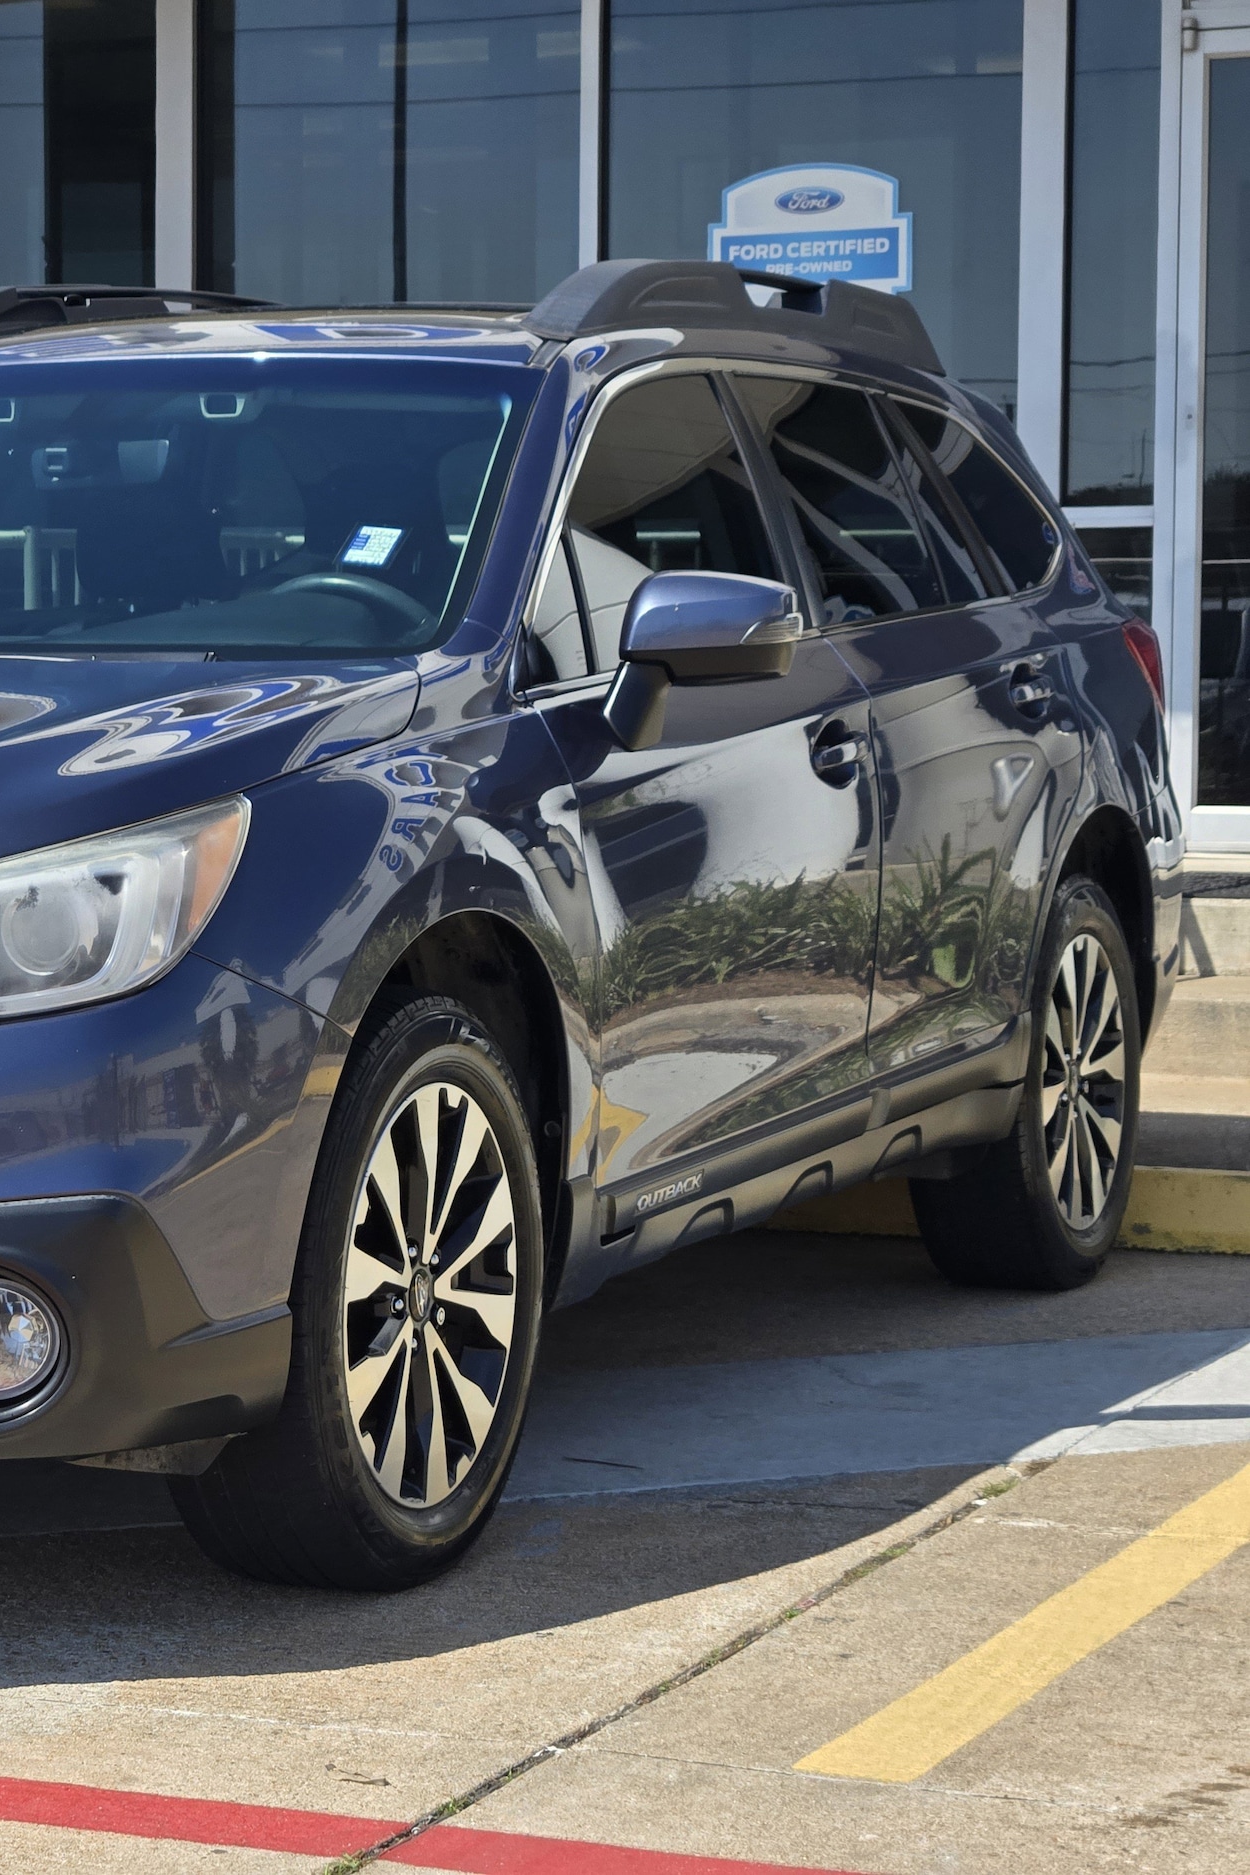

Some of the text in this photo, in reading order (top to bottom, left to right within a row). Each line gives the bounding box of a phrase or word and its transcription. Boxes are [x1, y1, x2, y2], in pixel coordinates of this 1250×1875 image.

[788, 191, 830, 210] Ford
[728, 238, 890, 261] FORD CERTIFIED
[766, 260, 852, 275] PRE-OWNED
[637, 1173, 703, 1211] OUTBACK
